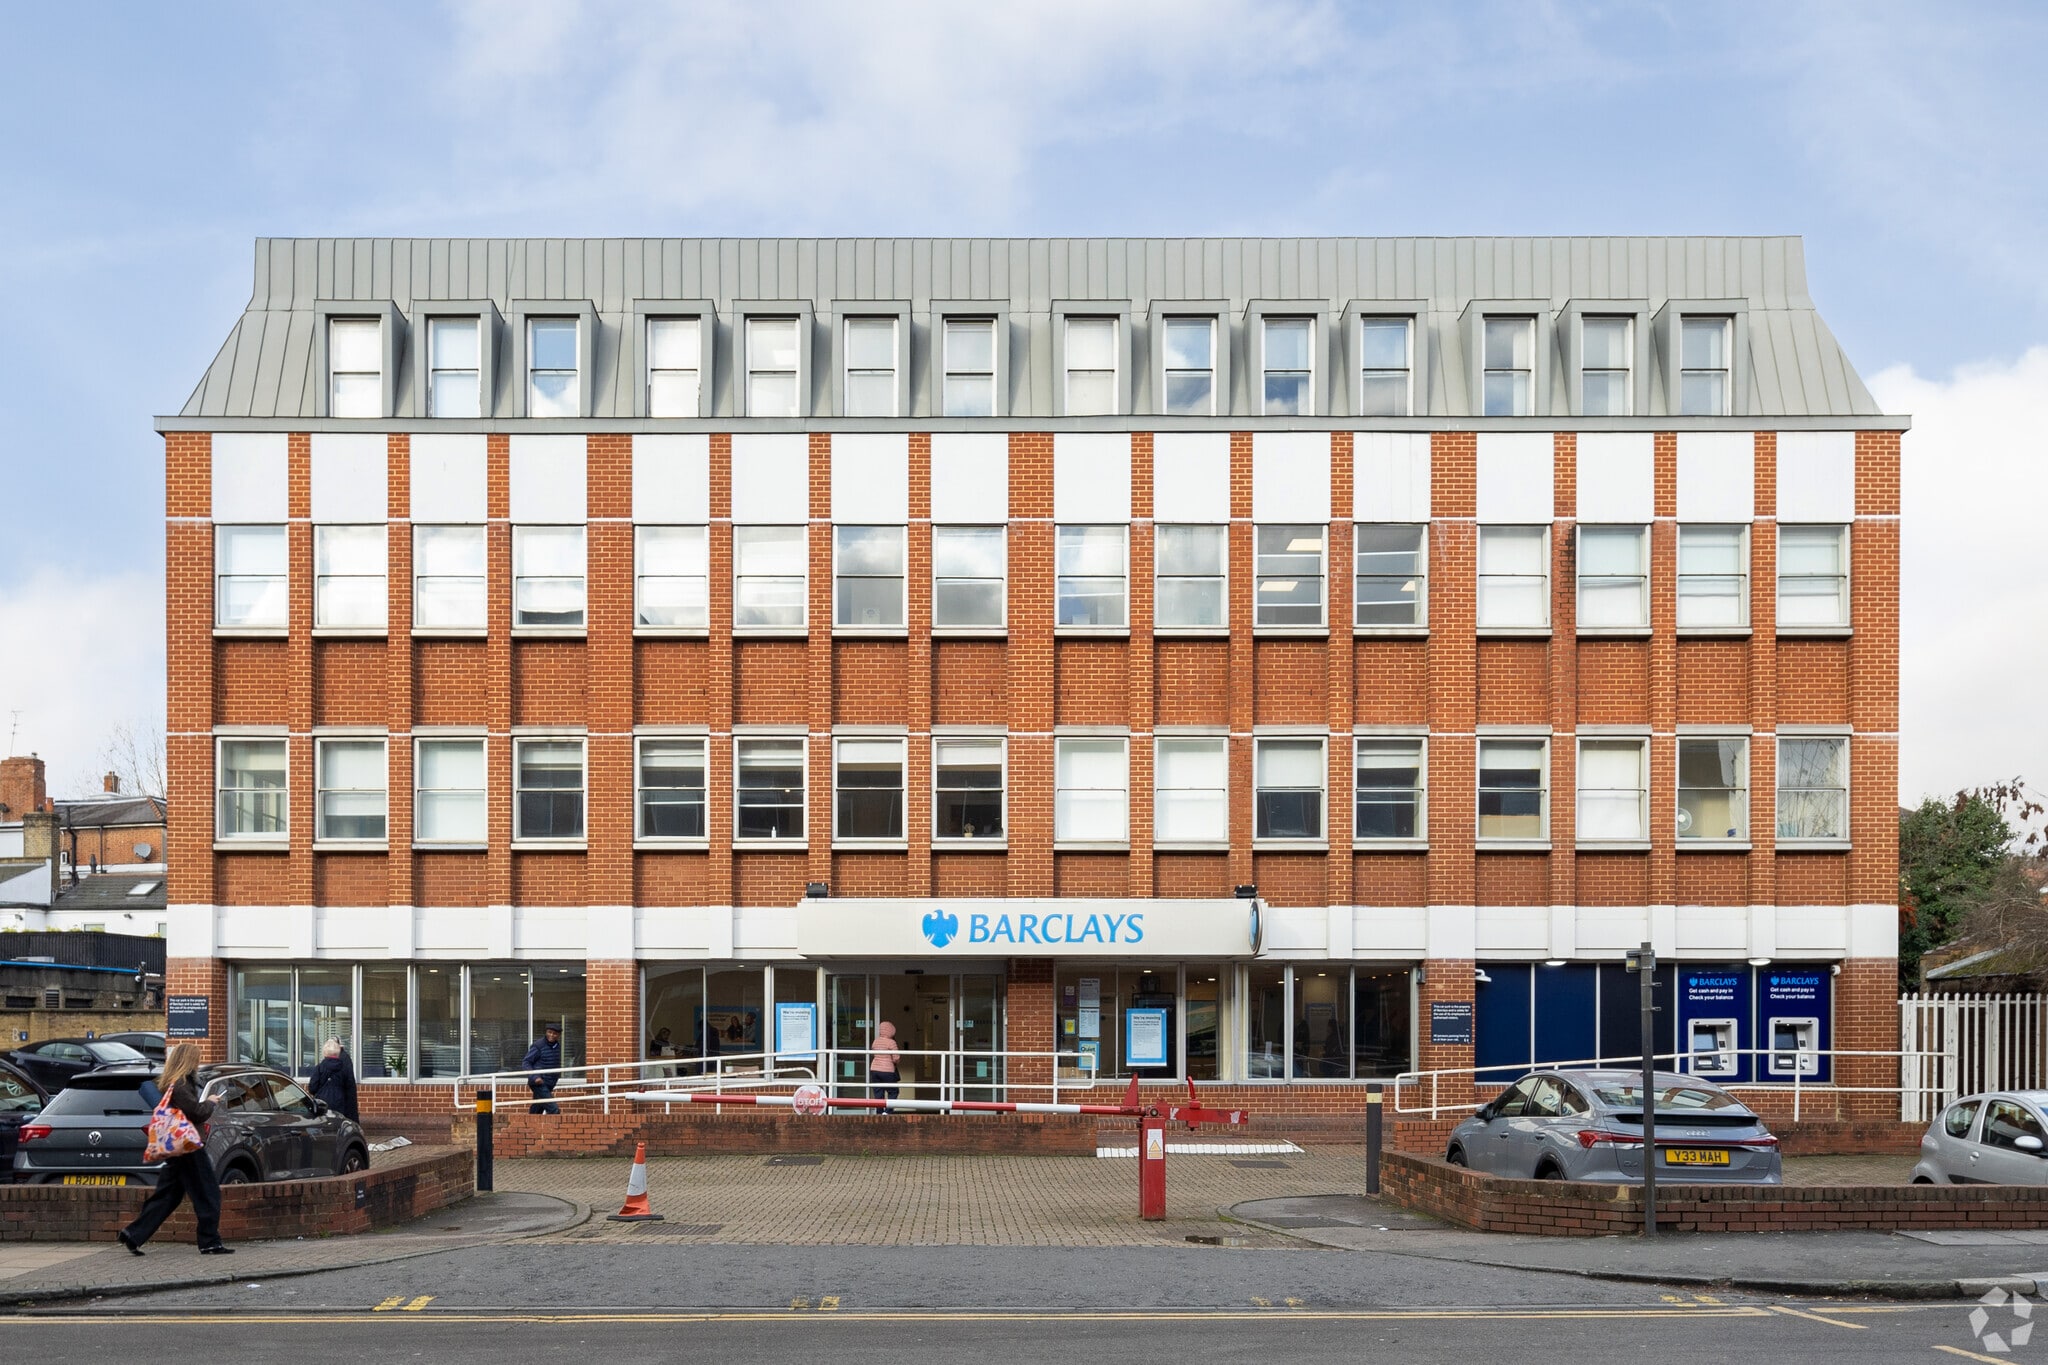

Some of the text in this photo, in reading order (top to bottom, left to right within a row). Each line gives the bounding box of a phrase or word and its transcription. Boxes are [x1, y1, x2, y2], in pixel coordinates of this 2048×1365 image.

[968, 914, 1144, 944] BARCLAYS
[1699, 978, 1738, 986] BARCLAYS
[1780, 977, 1819, 985] BARCLAYS
[797, 1096, 822, 1106] STOP
[1674, 1150, 1722, 1162] Y33 MAH
